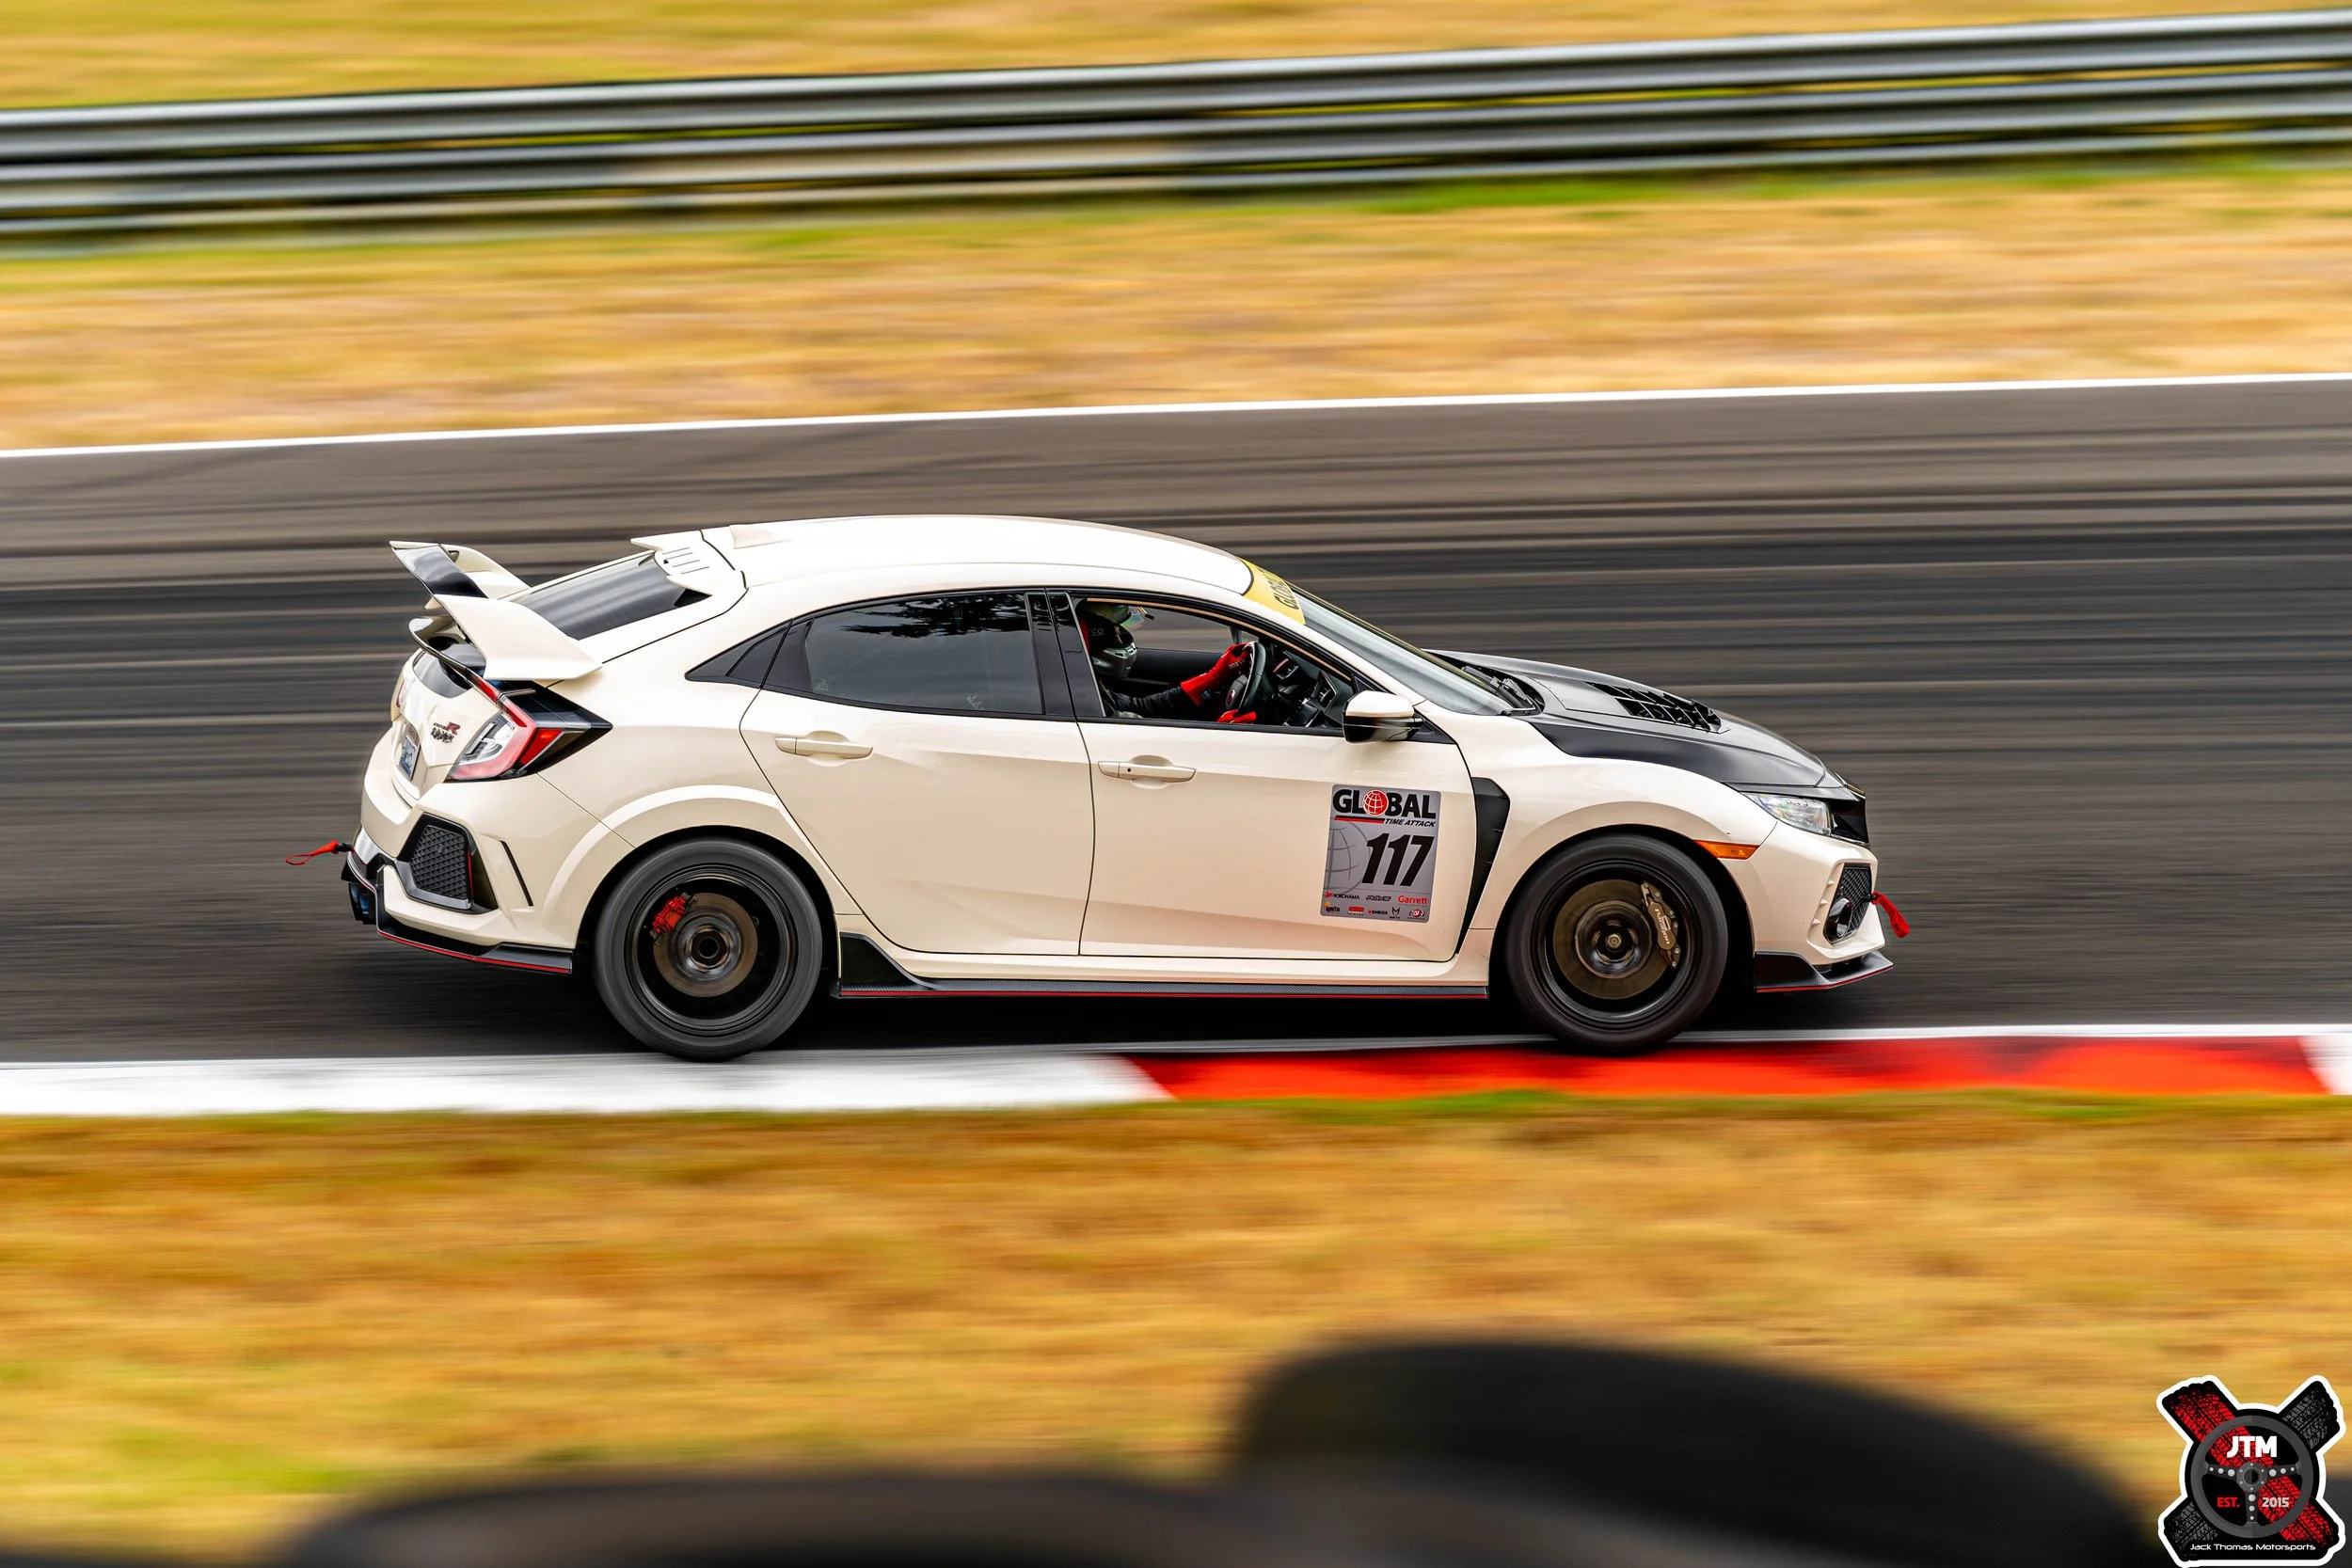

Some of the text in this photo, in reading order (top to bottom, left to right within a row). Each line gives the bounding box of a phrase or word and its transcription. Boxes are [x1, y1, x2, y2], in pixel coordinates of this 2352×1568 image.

[1332, 789, 1437, 819] GLOBAL
[1405, 819, 1437, 828] ATTACK
[1361, 832, 1435, 887] 117
[1398, 895, 1428, 904] Garrett
